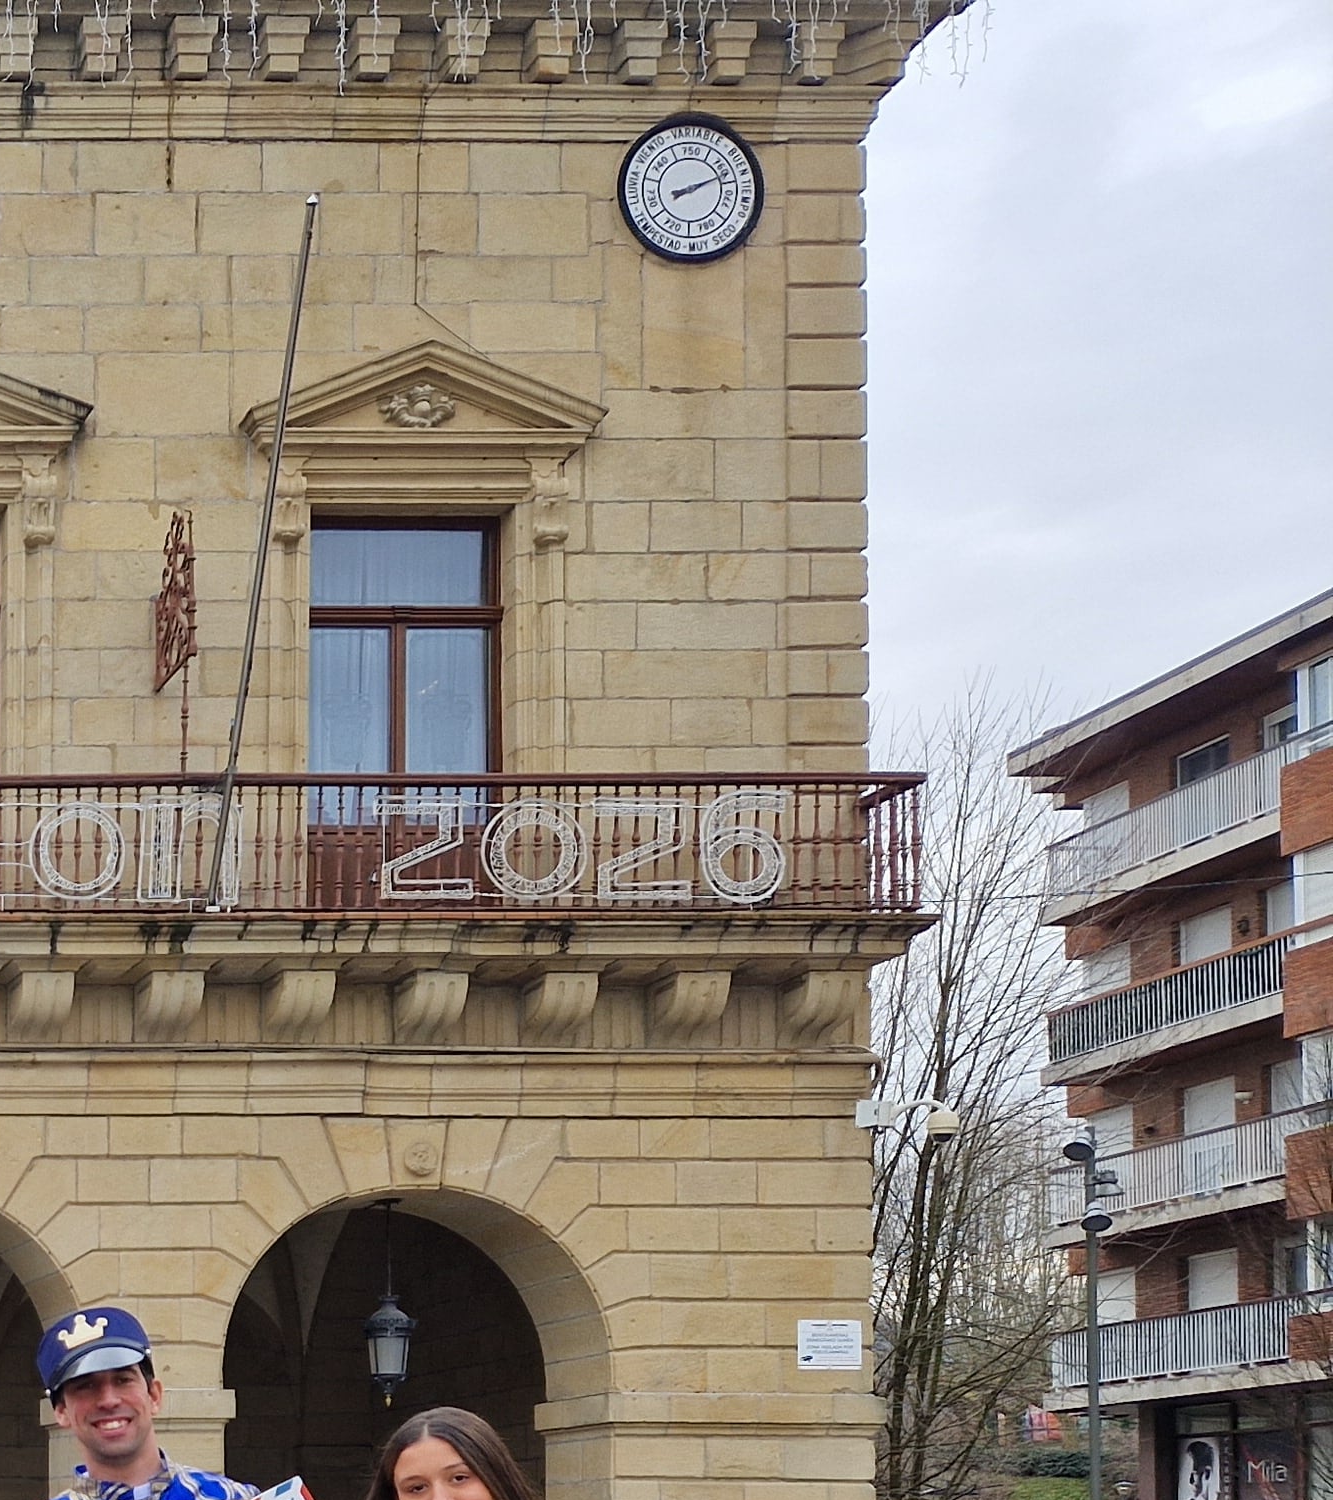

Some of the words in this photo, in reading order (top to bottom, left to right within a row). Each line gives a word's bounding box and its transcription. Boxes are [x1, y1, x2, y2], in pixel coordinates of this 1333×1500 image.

[670, 127, 724, 146] VARIABLE
[635, 135, 665, 164] VIENTO
[682, 146, 701, 156] 750
[727, 147, 750, 176] BUEN
[652, 156, 669, 173] 740
[628, 171, 641, 206] LLUVIA
[646, 189, 659, 208] 730
[721, 189, 734, 208] 770
[737, 178, 753, 219] TIEMPO
[634, 211, 682, 251] TEMPESTAD
[663, 217, 682, 232] 720
[697, 218, 716, 232] 780
[688, 241, 709, 252] MUY
[712, 223, 737, 246] SECO
[372, 789, 789, 905] 2026
[1247, 1459, 1288, 1484] Mila
